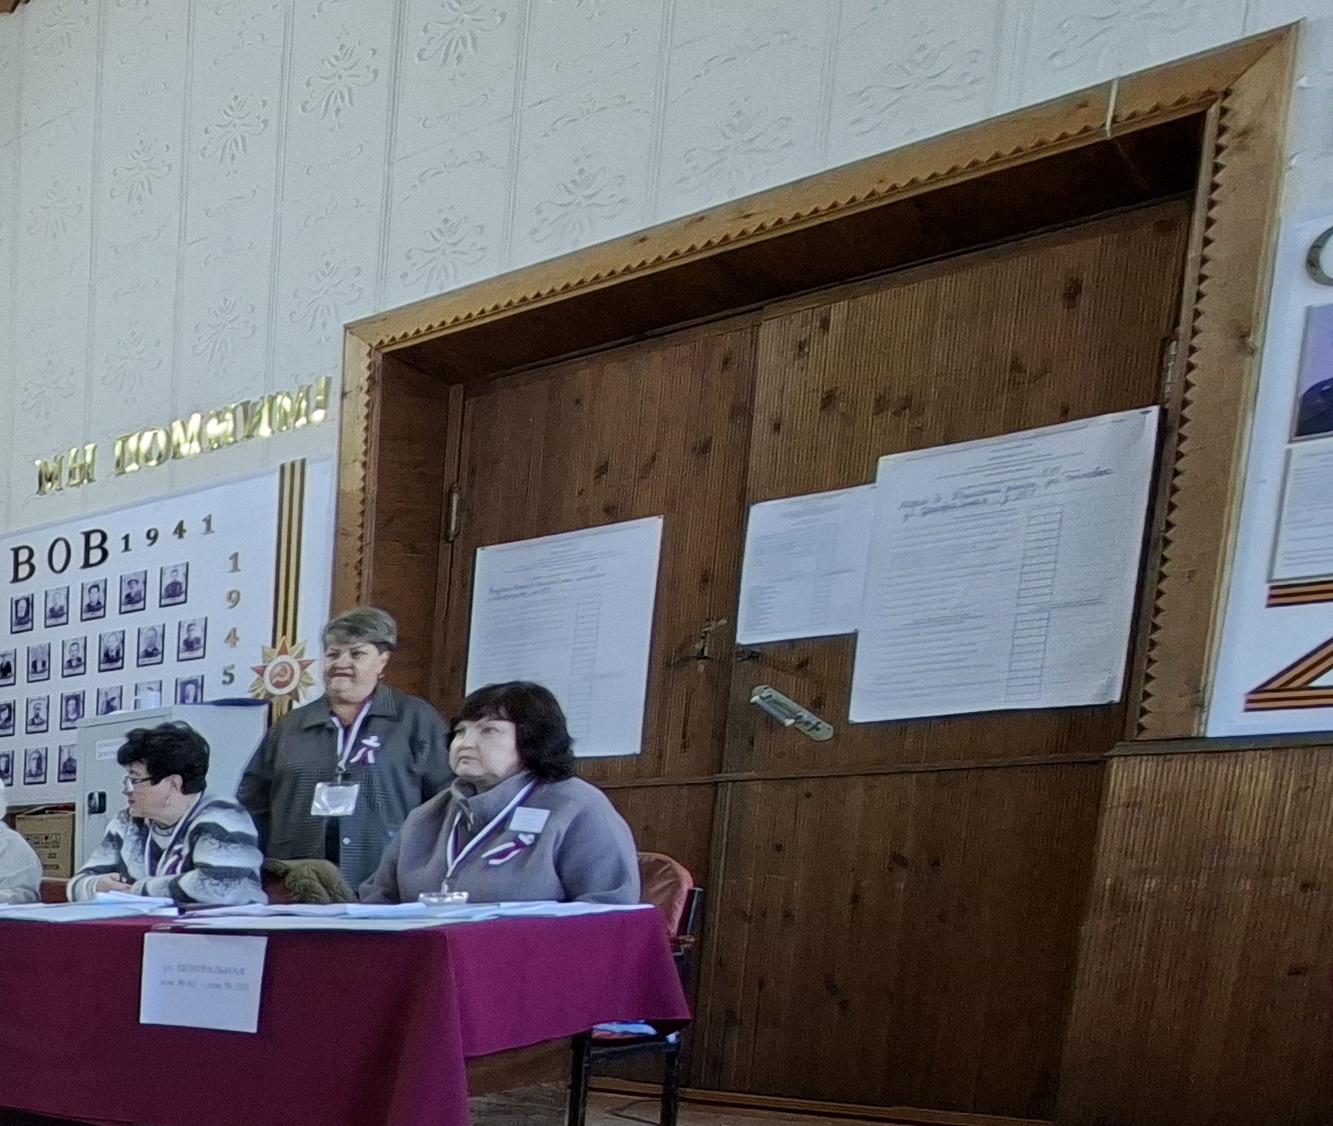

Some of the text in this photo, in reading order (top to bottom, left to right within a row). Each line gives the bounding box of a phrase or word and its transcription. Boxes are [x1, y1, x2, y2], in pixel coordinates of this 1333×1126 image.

[35, 376, 331, 495] МЫ ПОМНИМ!
[9, 514, 215, 584] ВОВ 1941
